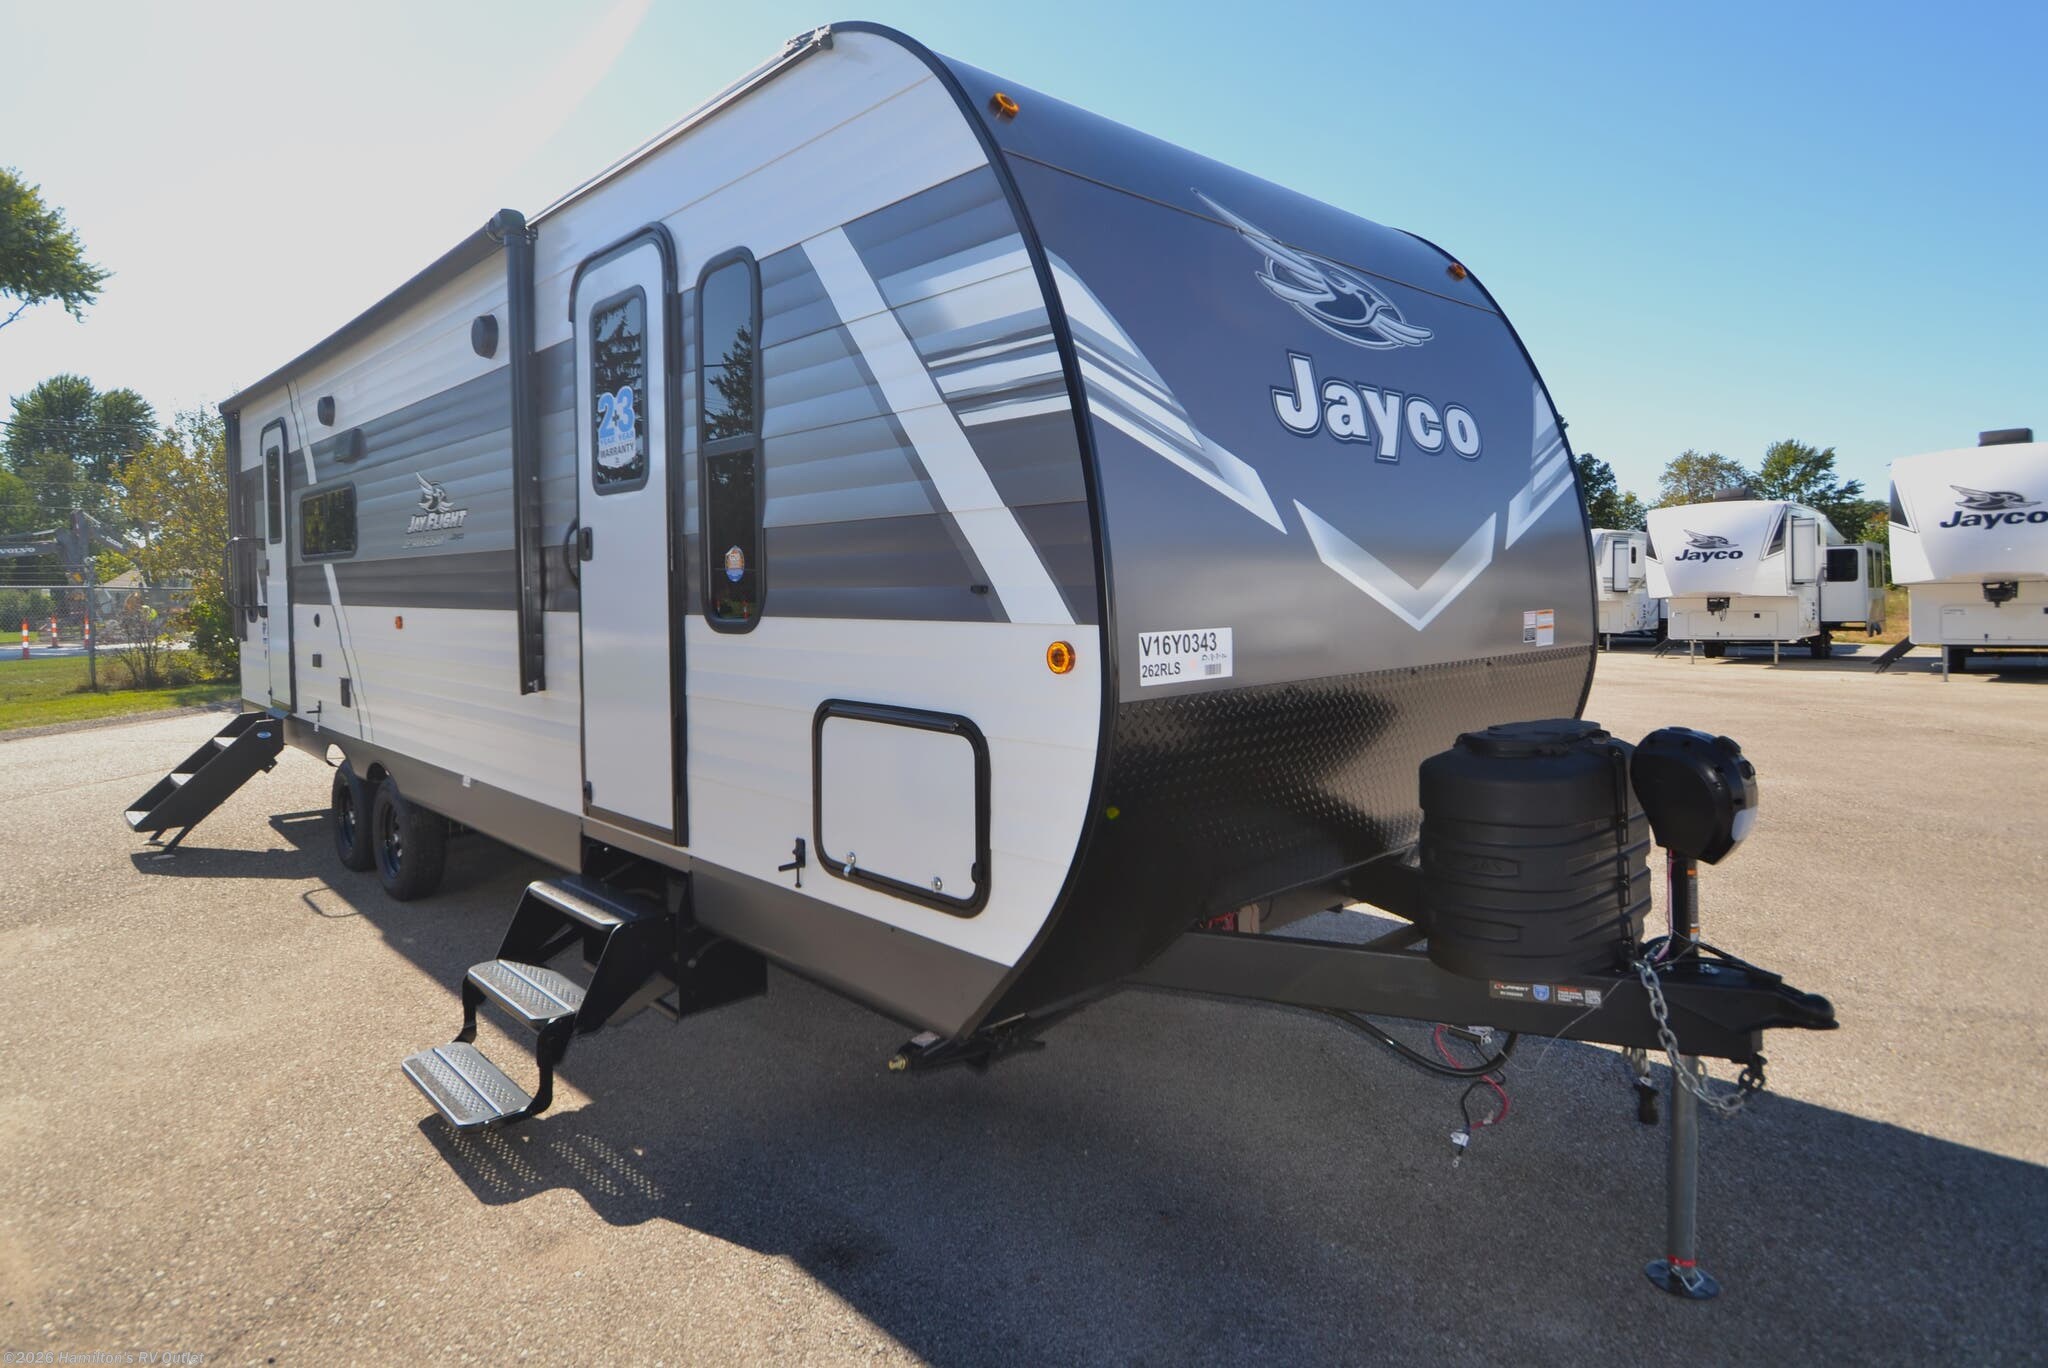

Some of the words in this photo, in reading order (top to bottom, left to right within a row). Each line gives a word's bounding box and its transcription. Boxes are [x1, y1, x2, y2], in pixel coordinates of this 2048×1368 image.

[1270, 350, 1482, 462] Jayco
[600, 442, 634, 458] WARRANTY
[407, 515, 426, 533] JAY
[427, 510, 467, 530] FLIGHT
[1940, 511, 2048, 529] Jayco
[1675, 549, 1743, 563] Jayco
[1140, 632, 1217, 657] V16Y0343
[1142, 661, 1181, 678] 262RLS
